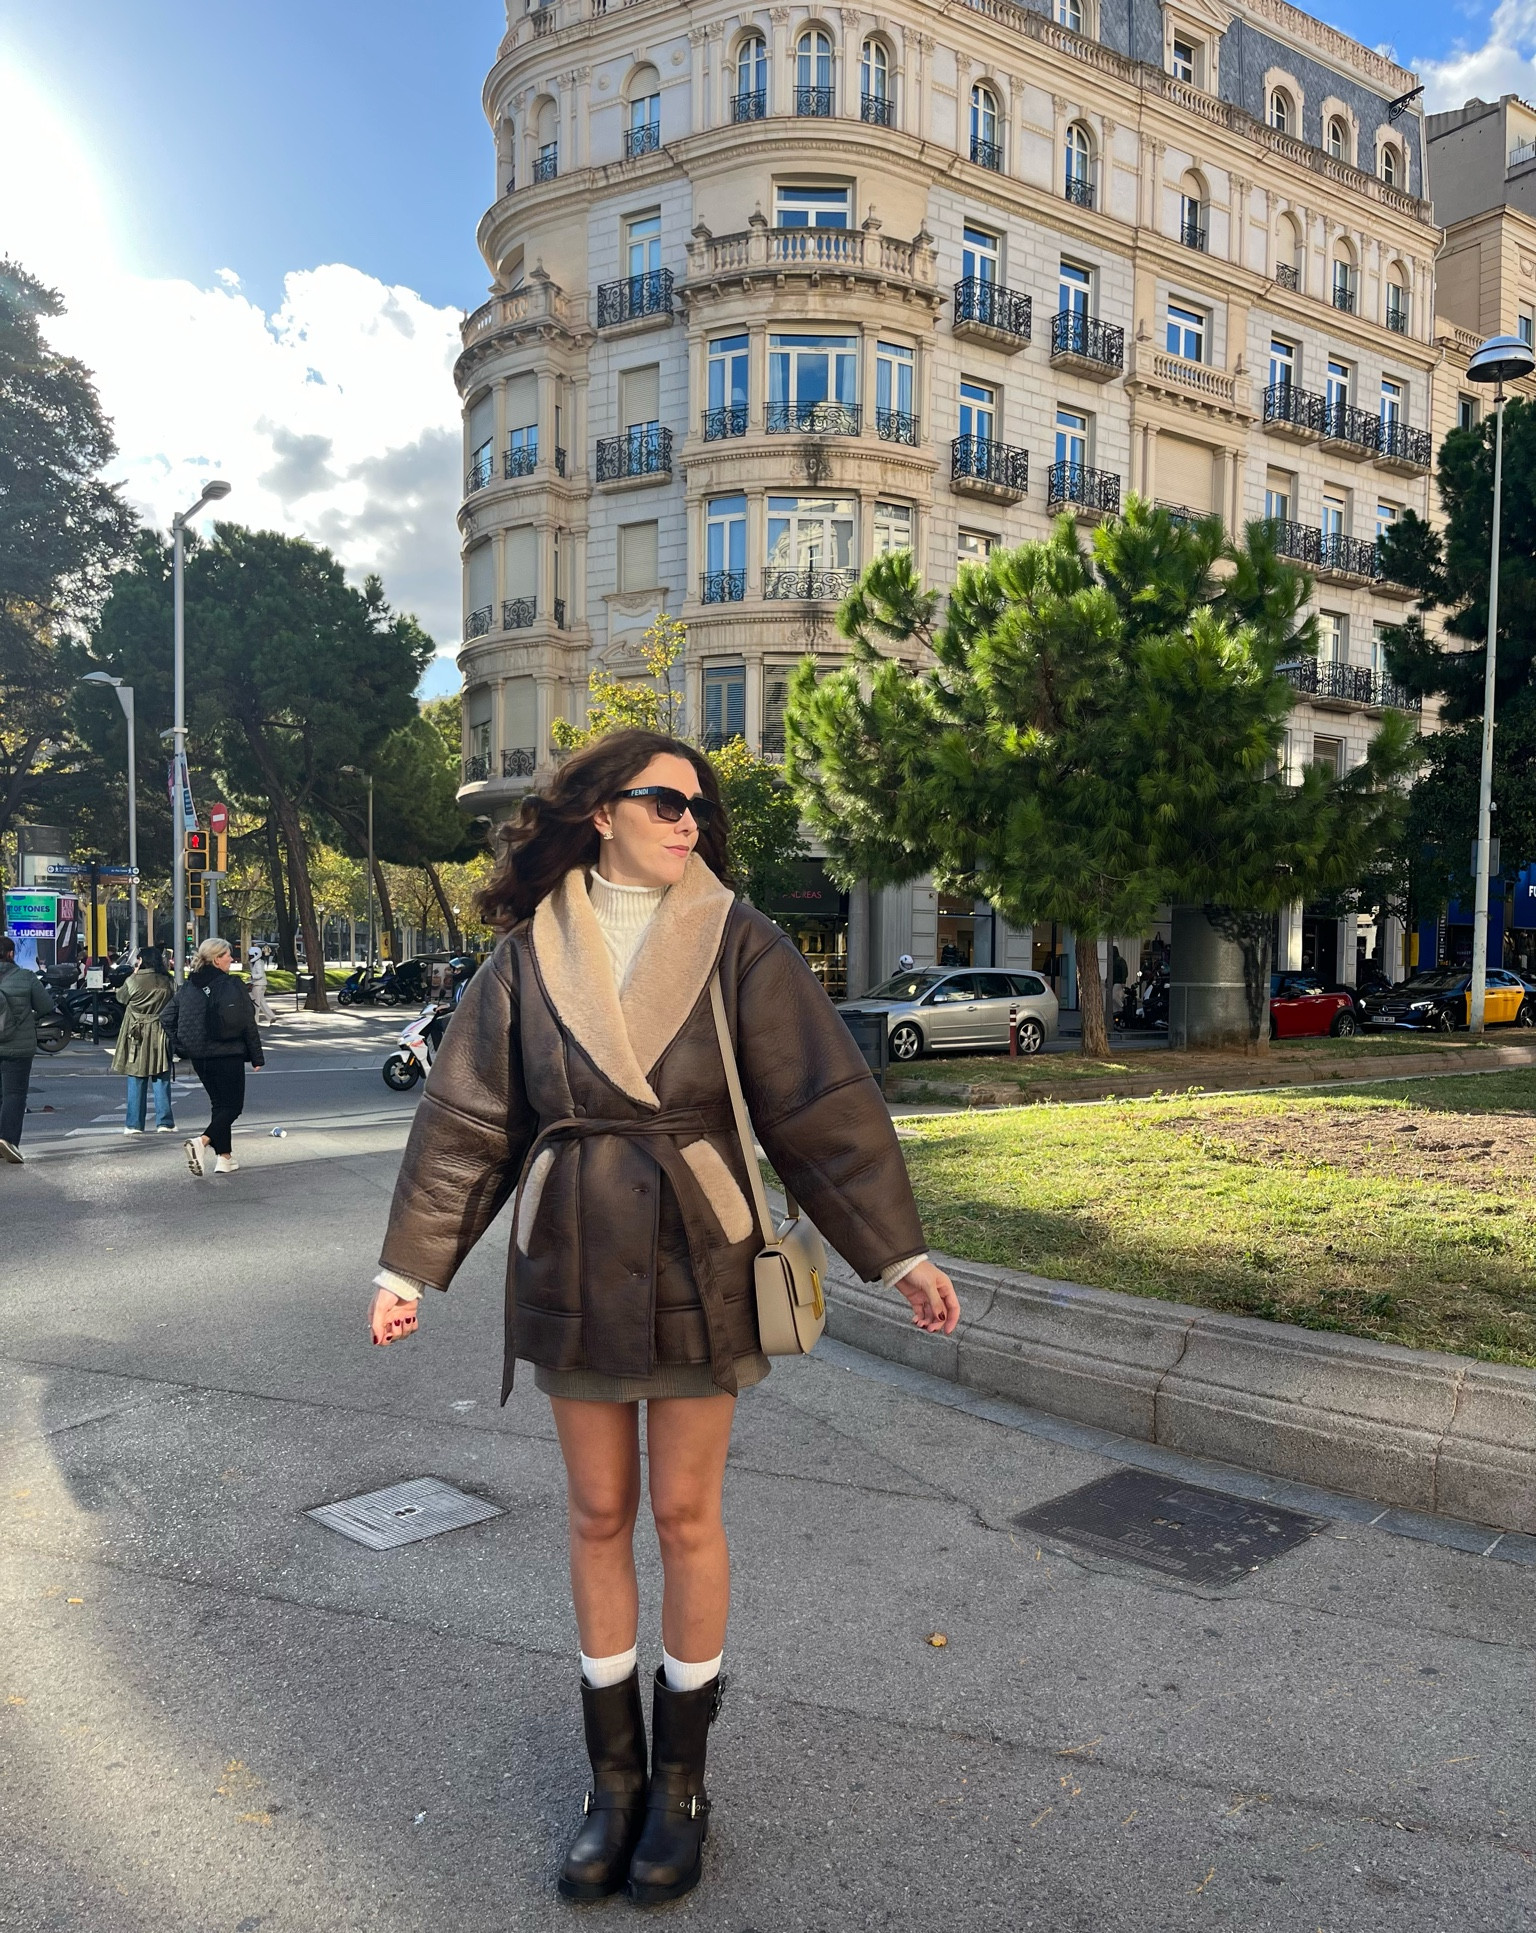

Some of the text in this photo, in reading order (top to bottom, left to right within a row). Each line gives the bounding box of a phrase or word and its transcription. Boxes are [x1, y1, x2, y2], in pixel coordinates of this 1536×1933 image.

[631, 788, 648, 796] FENDI
[782, 891, 822, 899] NDREAS
[23, 905, 50, 913] TONES
[21, 929, 54, 937] LUCINEE
